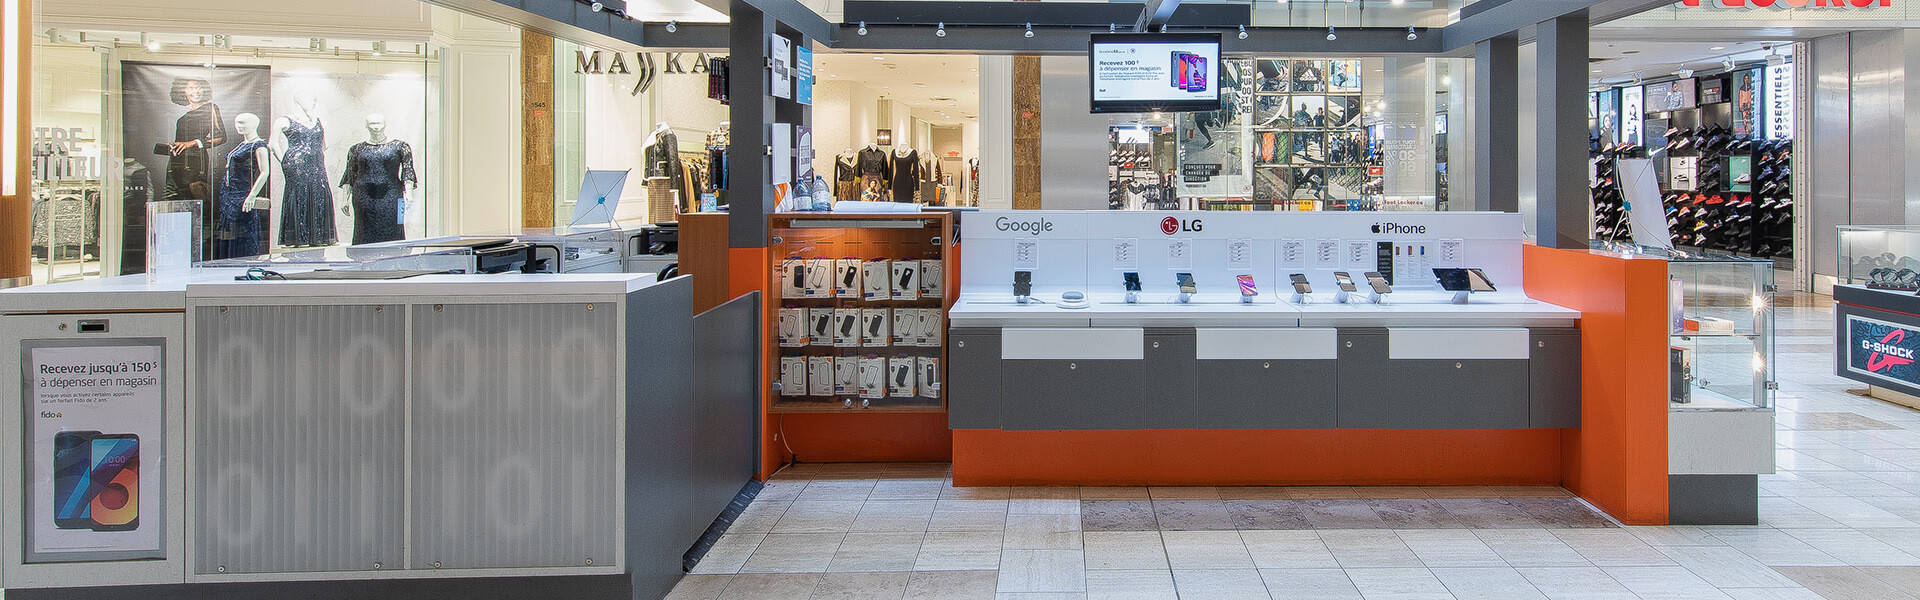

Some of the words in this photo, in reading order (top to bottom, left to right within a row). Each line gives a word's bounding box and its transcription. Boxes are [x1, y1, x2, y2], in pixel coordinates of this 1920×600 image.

[1775, 67, 1783, 139] ESSENTIELS
[995, 216, 1053, 235] Google
[1182, 219, 1203, 232] LG
[1382, 222, 1426, 234] iPhone
[1862, 340, 1915, 360] G-SHOCK
[40, 364, 87, 374] Recevez
[88, 362, 128, 376] jusqu'à
[131, 362, 151, 373] 150
[40, 378, 47, 388] à
[49, 377, 97, 389] dépenser
[100, 378, 113, 387] en
[115, 376, 157, 388] magasin
[40, 411, 56, 419] fido
